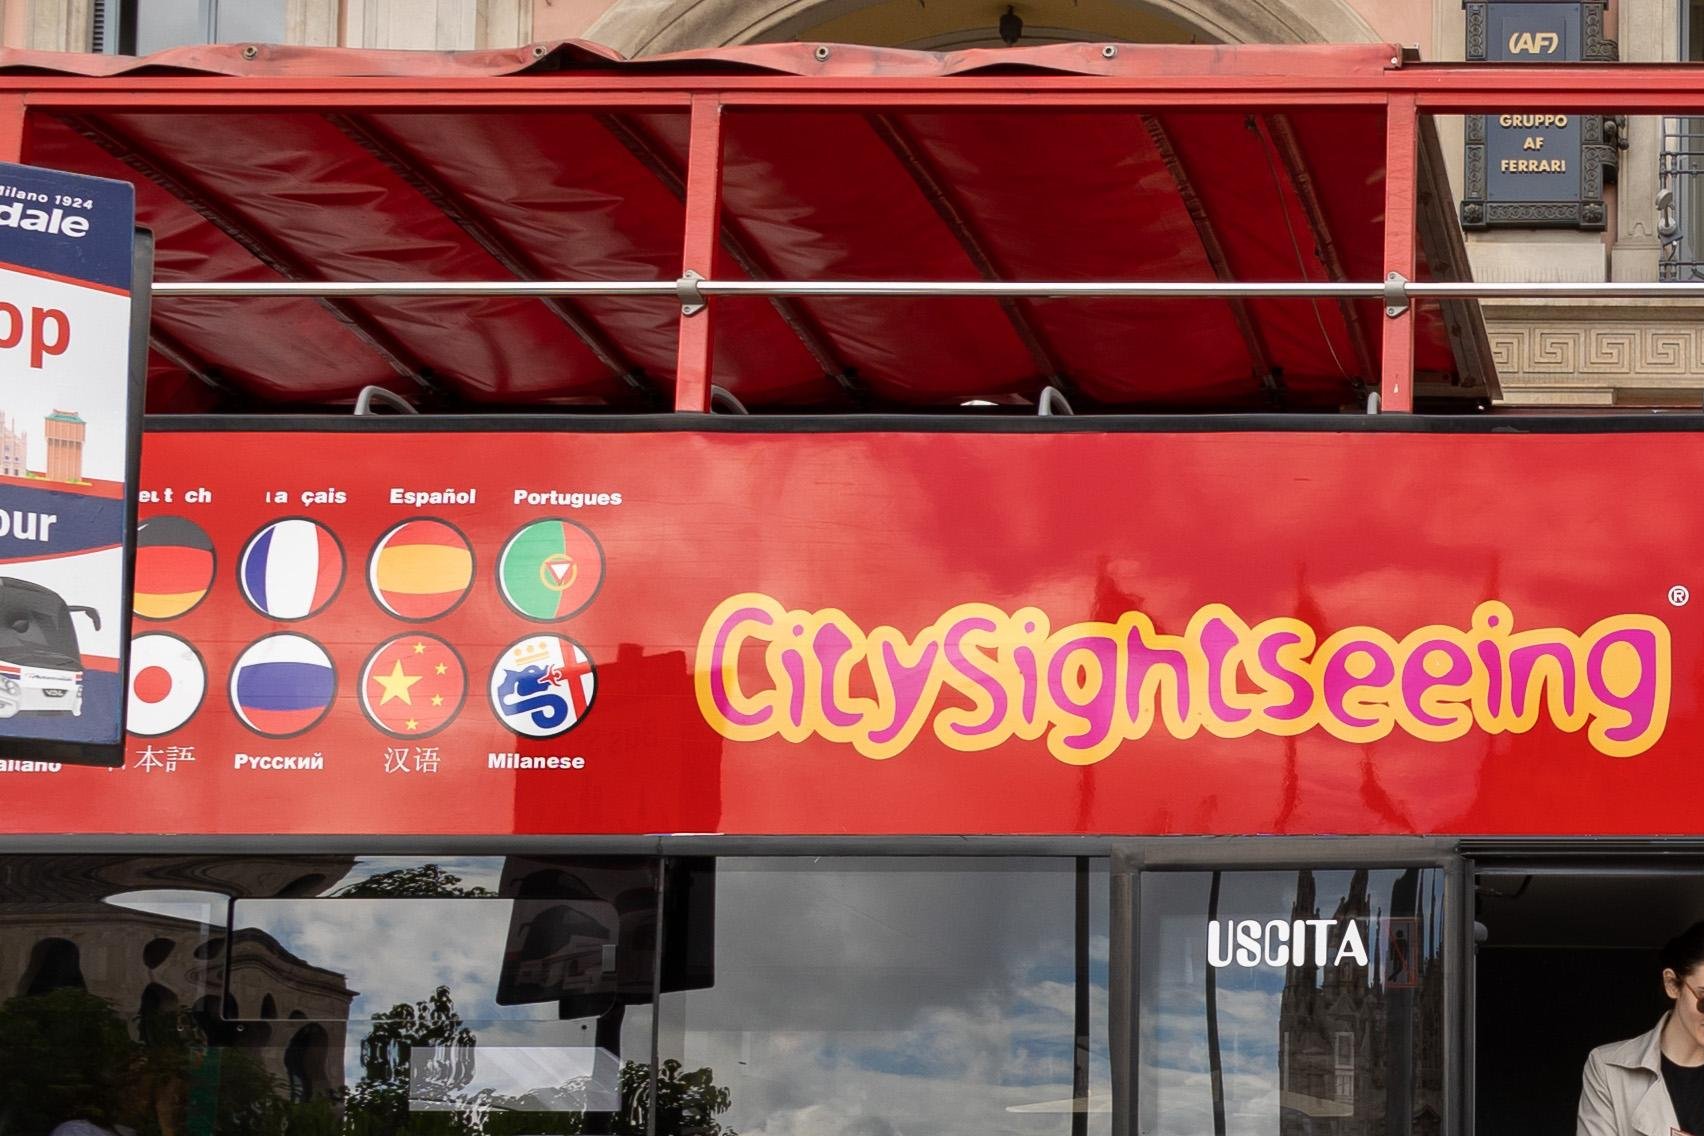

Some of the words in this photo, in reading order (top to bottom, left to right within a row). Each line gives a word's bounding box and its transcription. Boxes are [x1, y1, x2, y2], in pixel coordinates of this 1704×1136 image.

[1500, 115, 1568, 127] GRUPPO
[1523, 137, 1545, 150] AF
[1501, 160, 1567, 173] FERRARI
[0, 184, 49, 203] ilano
[55, 194, 94, 210] 1924
[390, 488, 477, 506] Español
[513, 490, 623, 507] Portugues
[107, 745, 196, 772] 本語
[234, 752, 324, 770] Русский
[384, 746, 441, 773] 汉语
[487, 753, 586, 770] Milanese
[1207, 919, 1369, 967] USCITA
